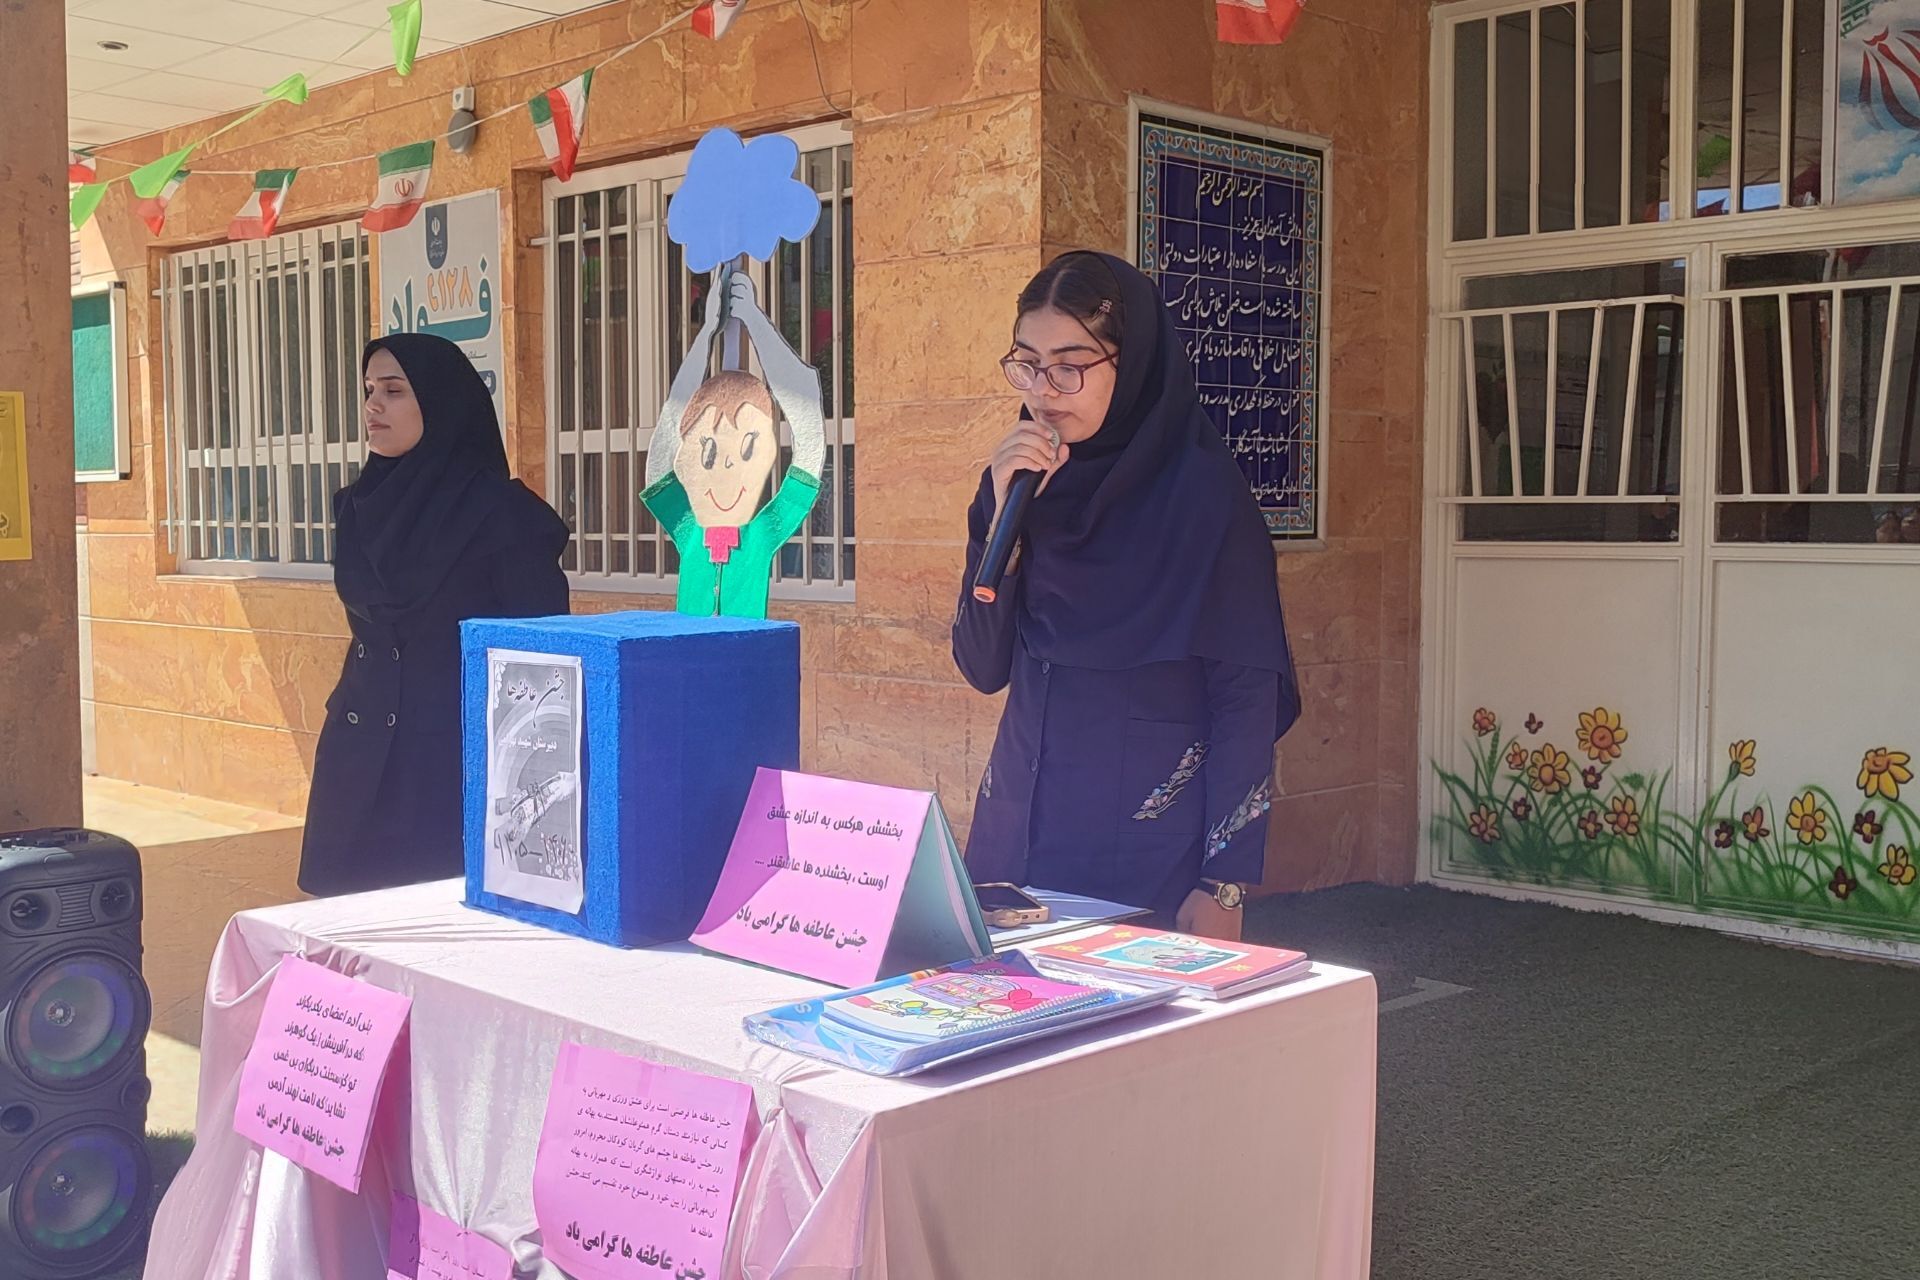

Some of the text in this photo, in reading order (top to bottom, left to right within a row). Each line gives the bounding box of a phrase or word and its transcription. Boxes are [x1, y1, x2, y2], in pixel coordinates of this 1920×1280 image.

[1195, 170, 1264, 217] بسم الله الرحمن الرحیم
[1255, 212, 1287, 241] آموزان
[1280, 212, 1301, 247] دانش
[1160, 242, 1182, 271] دولتی
[1183, 244, 1226, 272] اعتبارات
[1235, 249, 1261, 271] استفاده
[1266, 264, 1286, 275] مدرسه
[1285, 262, 1302, 285] این
[1182, 290, 1203, 321] برای
[1200, 288, 1225, 318] تلاش
[1217, 290, 1240, 328] ضمن
[1239, 299, 1266, 315] است
[1266, 297, 1282, 317] شده
[1281, 299, 1301, 320] ساخته
[1252, 338, 1278, 371] اخلاقی
[1271, 340, 1300, 373] فضایل
[1210, 394, 1230, 405] مدرسه
[1228, 375, 1266, 417] نگهداری
[1281, 384, 1300, 416] فنون
[1275, 423, 1300, 454] کوشا
[1260, 432, 1277, 463] باشید
[506, 668, 566, 729] جشن عاطفه ها
[766, 803, 902, 842] بخشش هرکس به اندازه عشق
[767, 855, 801, 872] عاشقند
[803, 860, 814, 875] ها
[814, 863, 852, 885] بخشنده
[736, 904, 868, 953] جشن عاطفه ها گرامی باد
[296, 995, 373, 1036] بنی آدم اعضای یکدیگرند
[284, 1021, 308, 1040] گوهرند
[305, 1028, 317, 1046] یک
[320, 1033, 350, 1055] آفرینش
[273, 1049, 290, 1062] غمی
[344, 1048, 353, 1059] در
[353, 1047, 366, 1061] که
[288, 1058, 299, 1071] بی
[298, 1057, 320, 1077] دیگران
[319, 1064, 341, 1085] محنت
[347, 1078, 358, 1093] تو
[267, 1076, 347, 1120] نشاید که نامت نهند آدمی
[587, 1087, 606, 1100] مهربانی
[612, 1094, 628, 1106] ورزی
[628, 1095, 642, 1107] عشق
[642, 1099, 656, 1112] برای
[656, 1103, 670, 1112] است
[691, 1107, 698, 1119] ها
[699, 1111, 716, 1123] عاطفه
[716, 1117, 731, 1130] جشن
[256, 1103, 345, 1161] جشن عاطفه ها گرامی باد
[651, 1122, 663, 1136] گرم
[702, 1135, 710, 1144] که
[709, 1138, 728, 1150] کسانی
[644, 1144, 656, 1156] های
[656, 1148, 671, 1161] چشم
[672, 1149, 679, 1159] ها
[590, 1152, 608, 1165] همواره
[610, 1156, 619, 1165] که
[619, 1160, 633, 1169] است
[680, 1153, 696, 1164] عاطفه
[697, 1158, 712, 1170] جشن
[712, 1166, 724, 1175] روز
[592, 1178, 602, 1187] می
[618, 1183, 631, 1194] خود
[688, 1177, 698, 1191] راه
[705, 1184, 721, 1198] چشم
[657, 1193, 670, 1205] خود
[680, 1198, 688, 1211] را
[690, 1222, 713, 1239] عاطفه ها
[565, 1220, 706, 1280] جشن عاطفه ها گرامی باد
